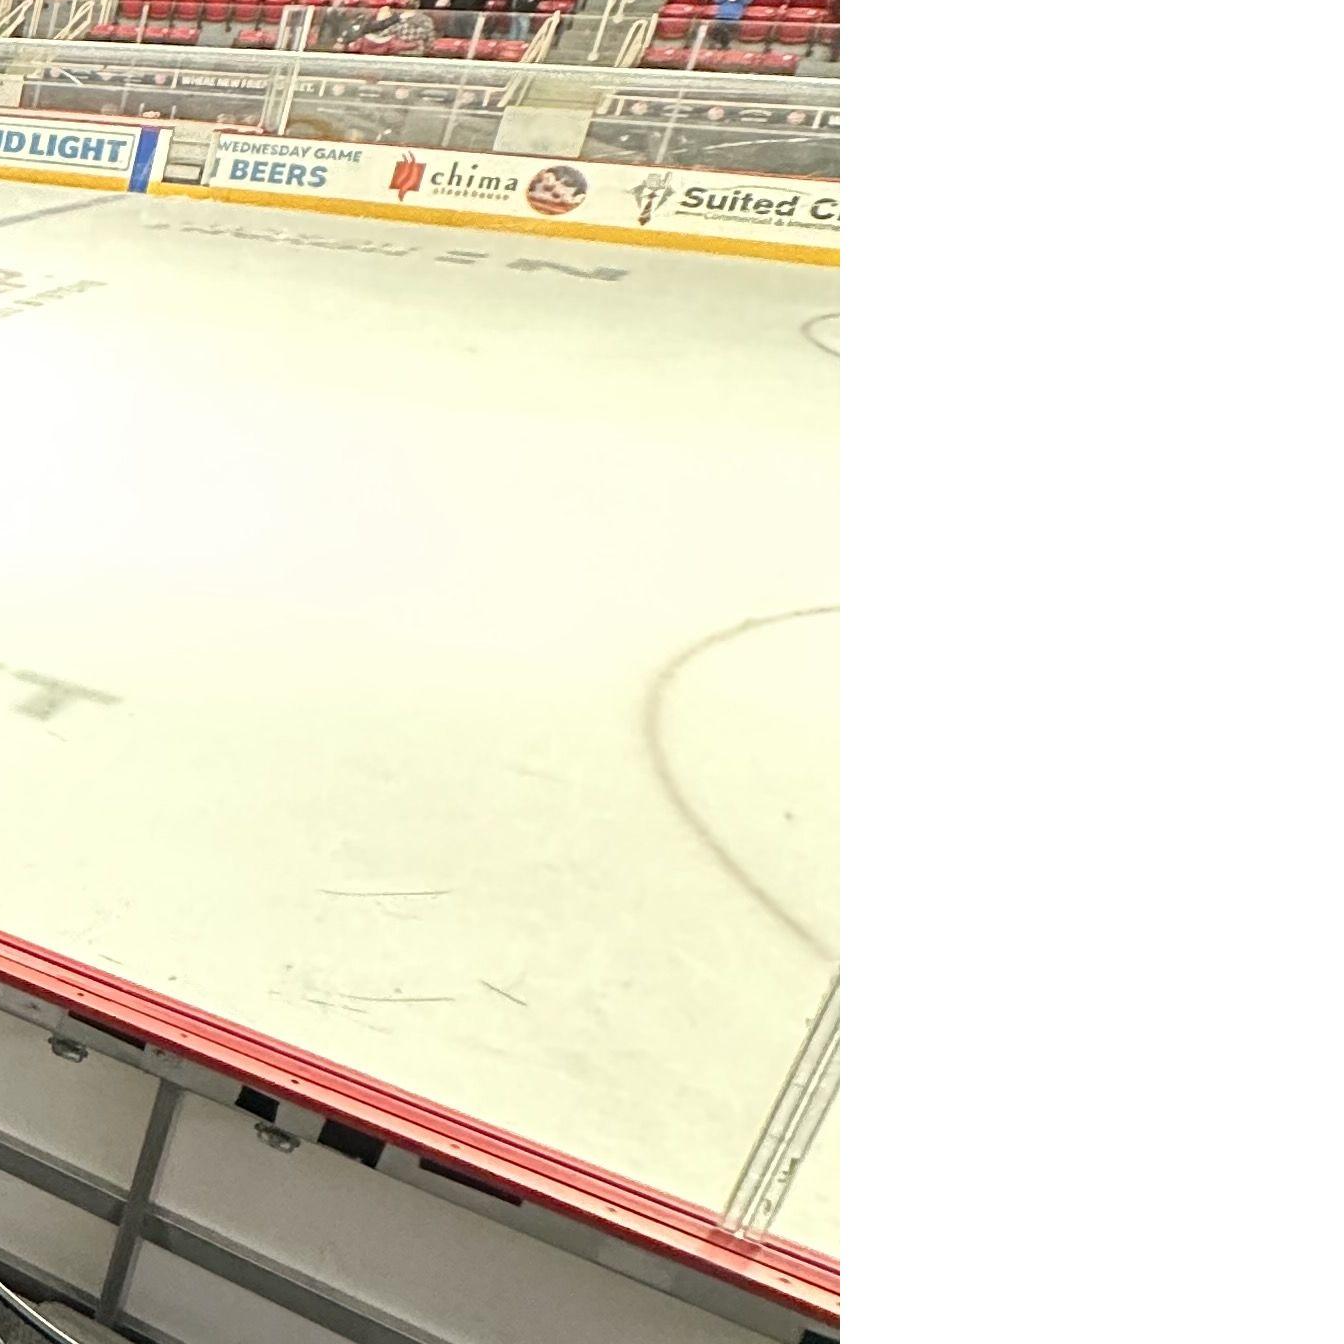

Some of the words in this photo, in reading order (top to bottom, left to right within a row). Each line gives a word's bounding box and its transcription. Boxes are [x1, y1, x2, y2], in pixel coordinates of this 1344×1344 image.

[29, 131, 127, 163] LIGHT
[218, 140, 311, 157] WEDNESDAY
[313, 147, 363, 163] GAME
[230, 158, 328, 187] BEERS
[430, 161, 518, 192] chima
[680, 186, 800, 217] Suited
[811, 197, 840, 223] C
